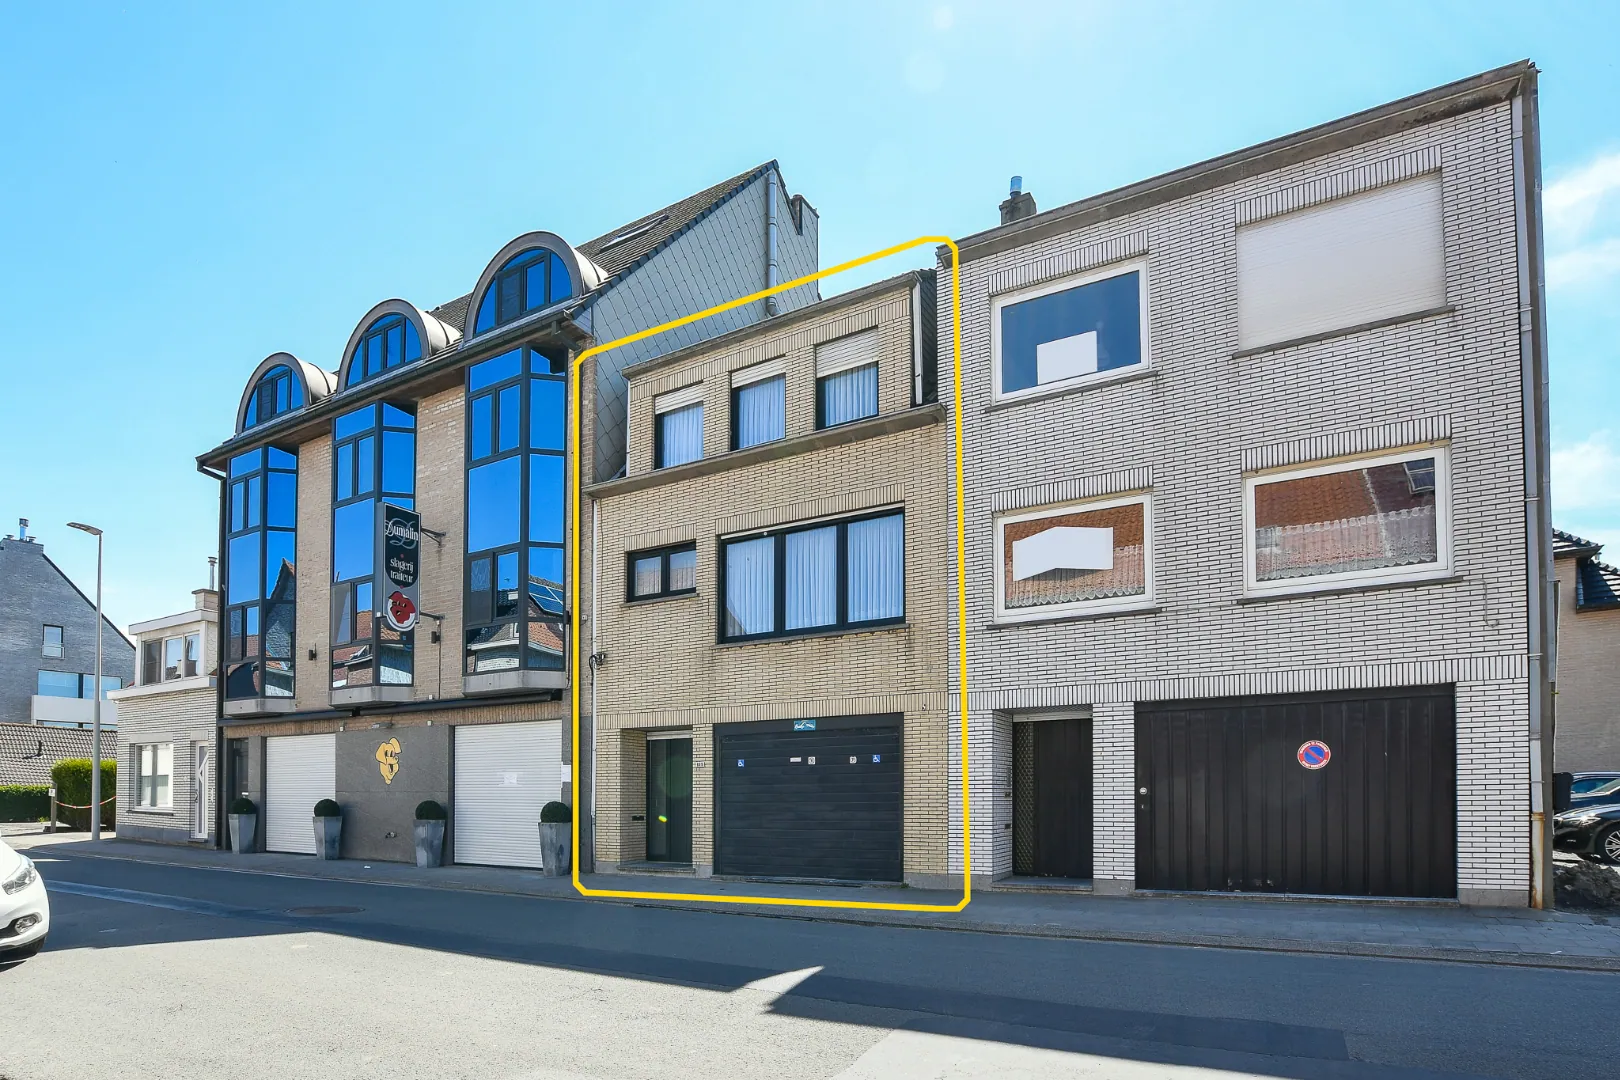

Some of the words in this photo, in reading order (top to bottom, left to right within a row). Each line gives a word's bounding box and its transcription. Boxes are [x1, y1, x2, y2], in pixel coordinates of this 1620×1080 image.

[385, 519, 419, 541] Dumalin
[390, 557, 414, 574] slagerij
[390, 570, 414, 583] traiteur
